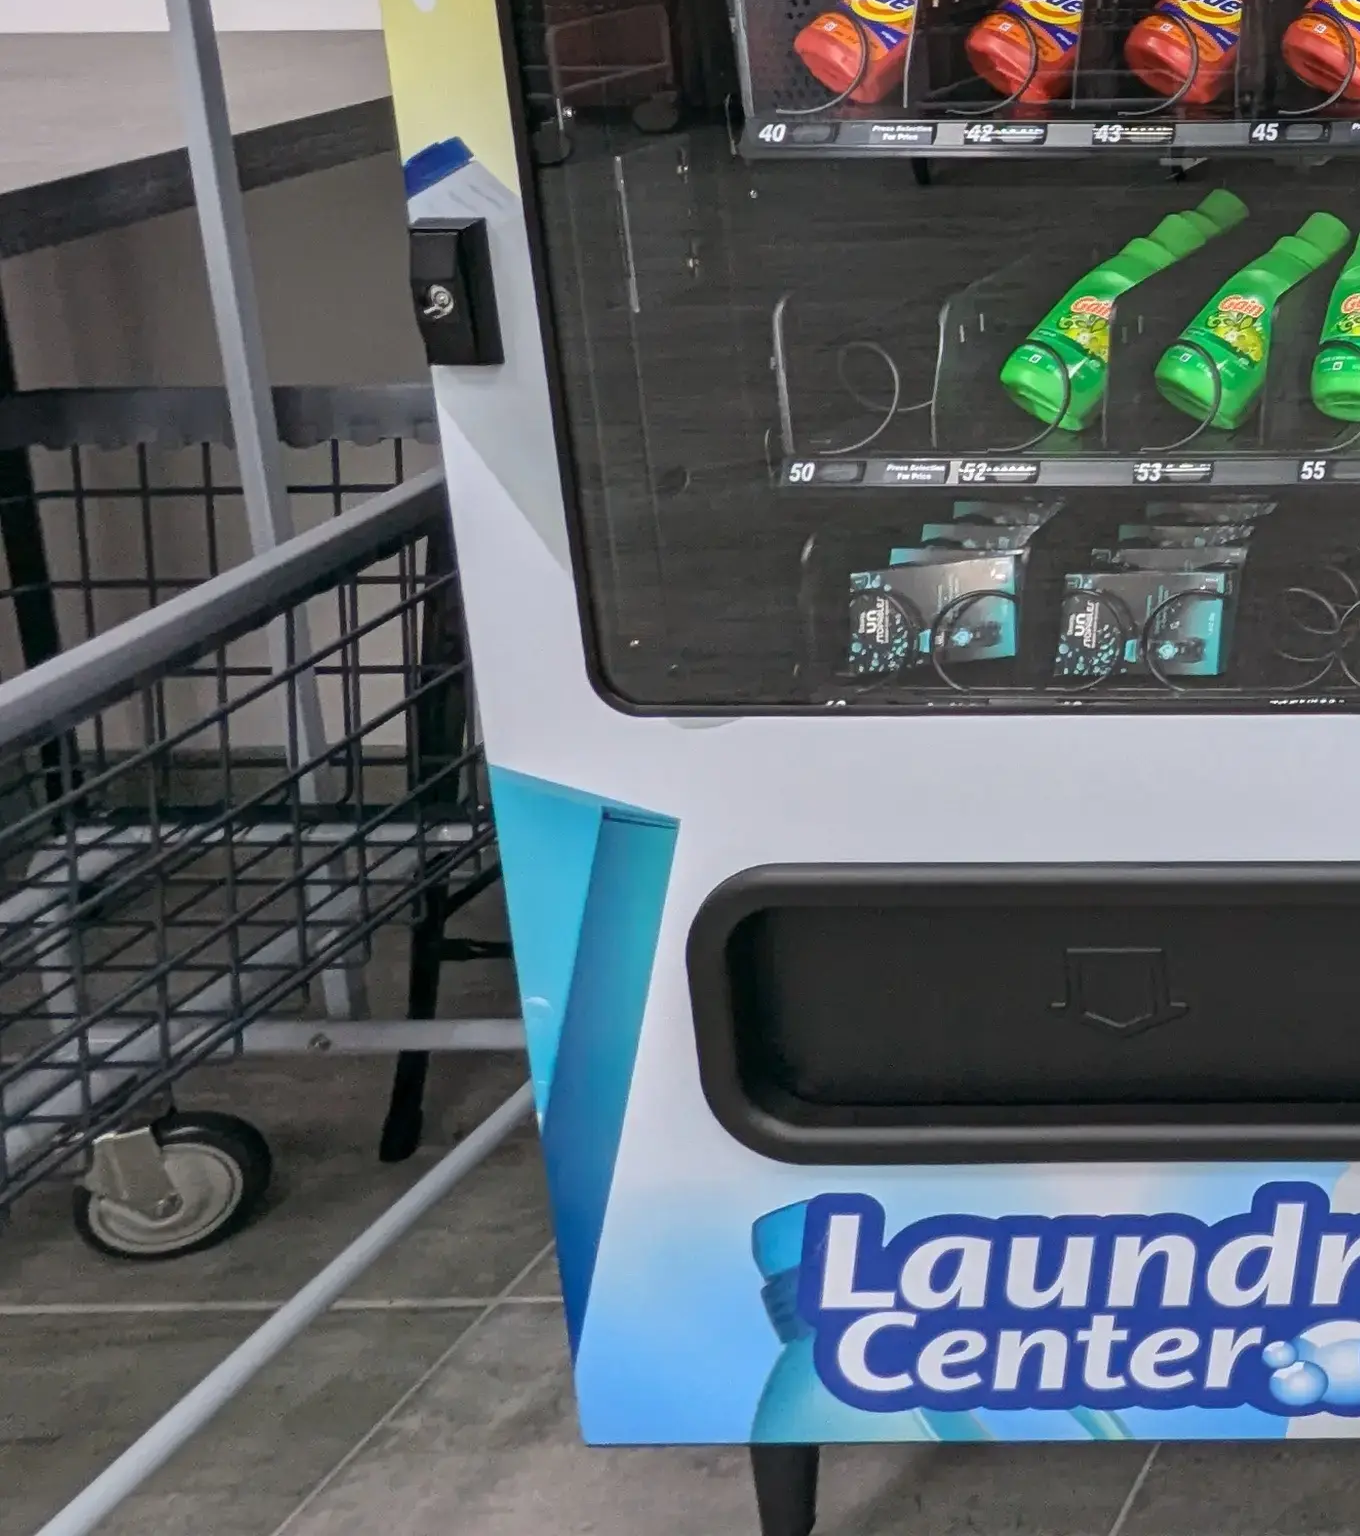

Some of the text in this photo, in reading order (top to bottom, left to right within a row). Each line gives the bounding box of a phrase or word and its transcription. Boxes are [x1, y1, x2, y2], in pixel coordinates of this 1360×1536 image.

[759, 124, 786, 141] 40
[1253, 123, 1278, 140] 45
[1219, 295, 1264, 317] Gain
[789, 464, 814, 481] 50
[1301, 462, 1326, 480] 55
[838, 1312, 1262, 1391] Center
